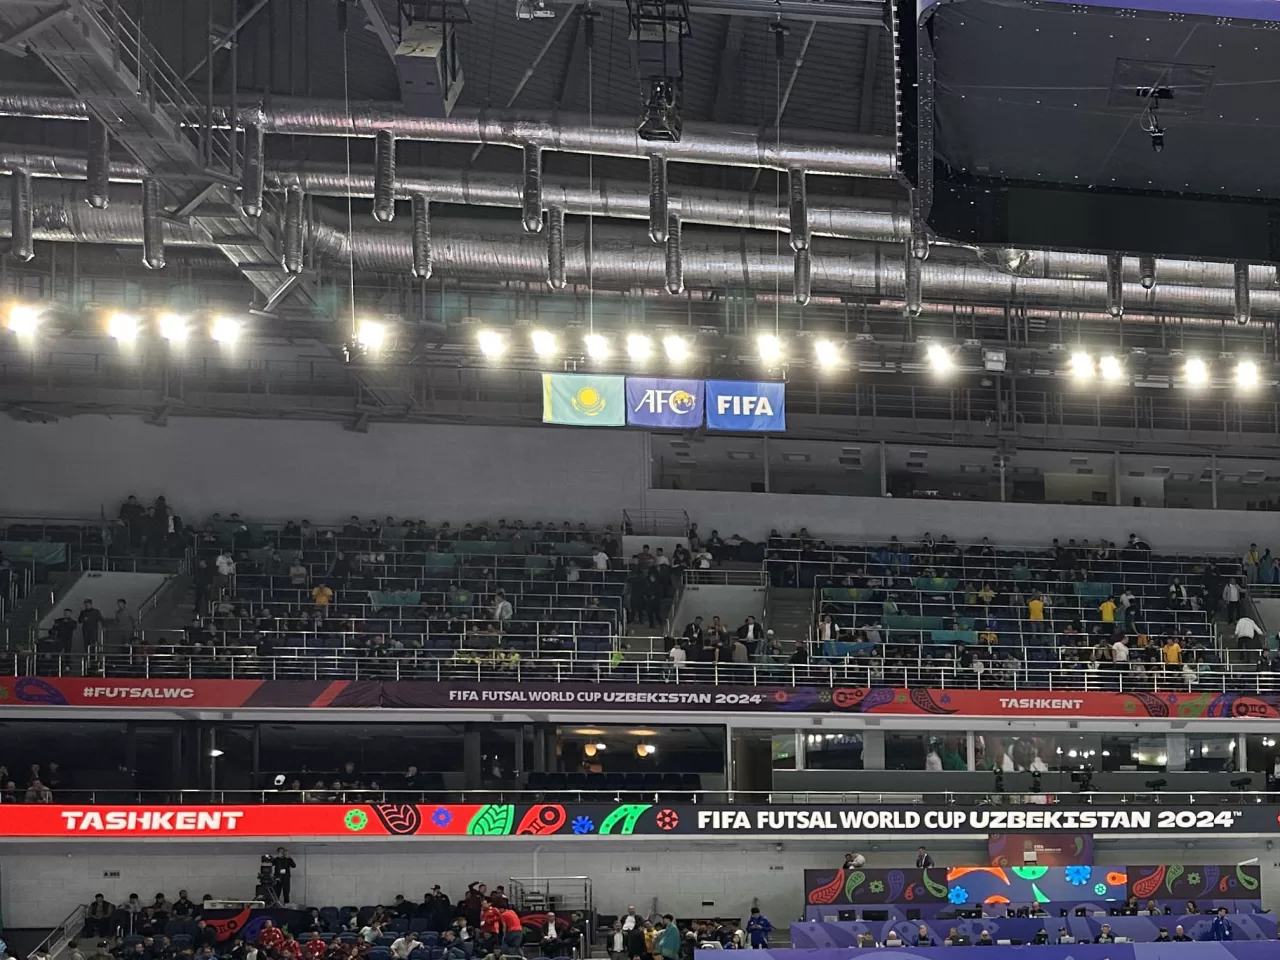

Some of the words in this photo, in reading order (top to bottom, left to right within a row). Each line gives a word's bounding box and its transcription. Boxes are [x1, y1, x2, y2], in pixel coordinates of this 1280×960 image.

[717, 395, 774, 416] FIFA
[83, 686, 194, 699] #FUTSALWC
[449, 690, 479, 701] FIFA
[482, 690, 527, 702] FUTSAL
[528, 691, 574, 702] WORLD
[577, 692, 602, 702] CUP
[603, 692, 711, 704] UZBEKISTAN
[999, 698, 1084, 709] TASHKENT
[61, 811, 244, 829] TASHKENT
[699, 810, 752, 829] FIFA
[757, 810, 838, 829] FUTSAL
[838, 810, 921, 829] WORLD
[925, 810, 967, 829] CUP
[969, 811, 1151, 829] UZBEKISTAN
